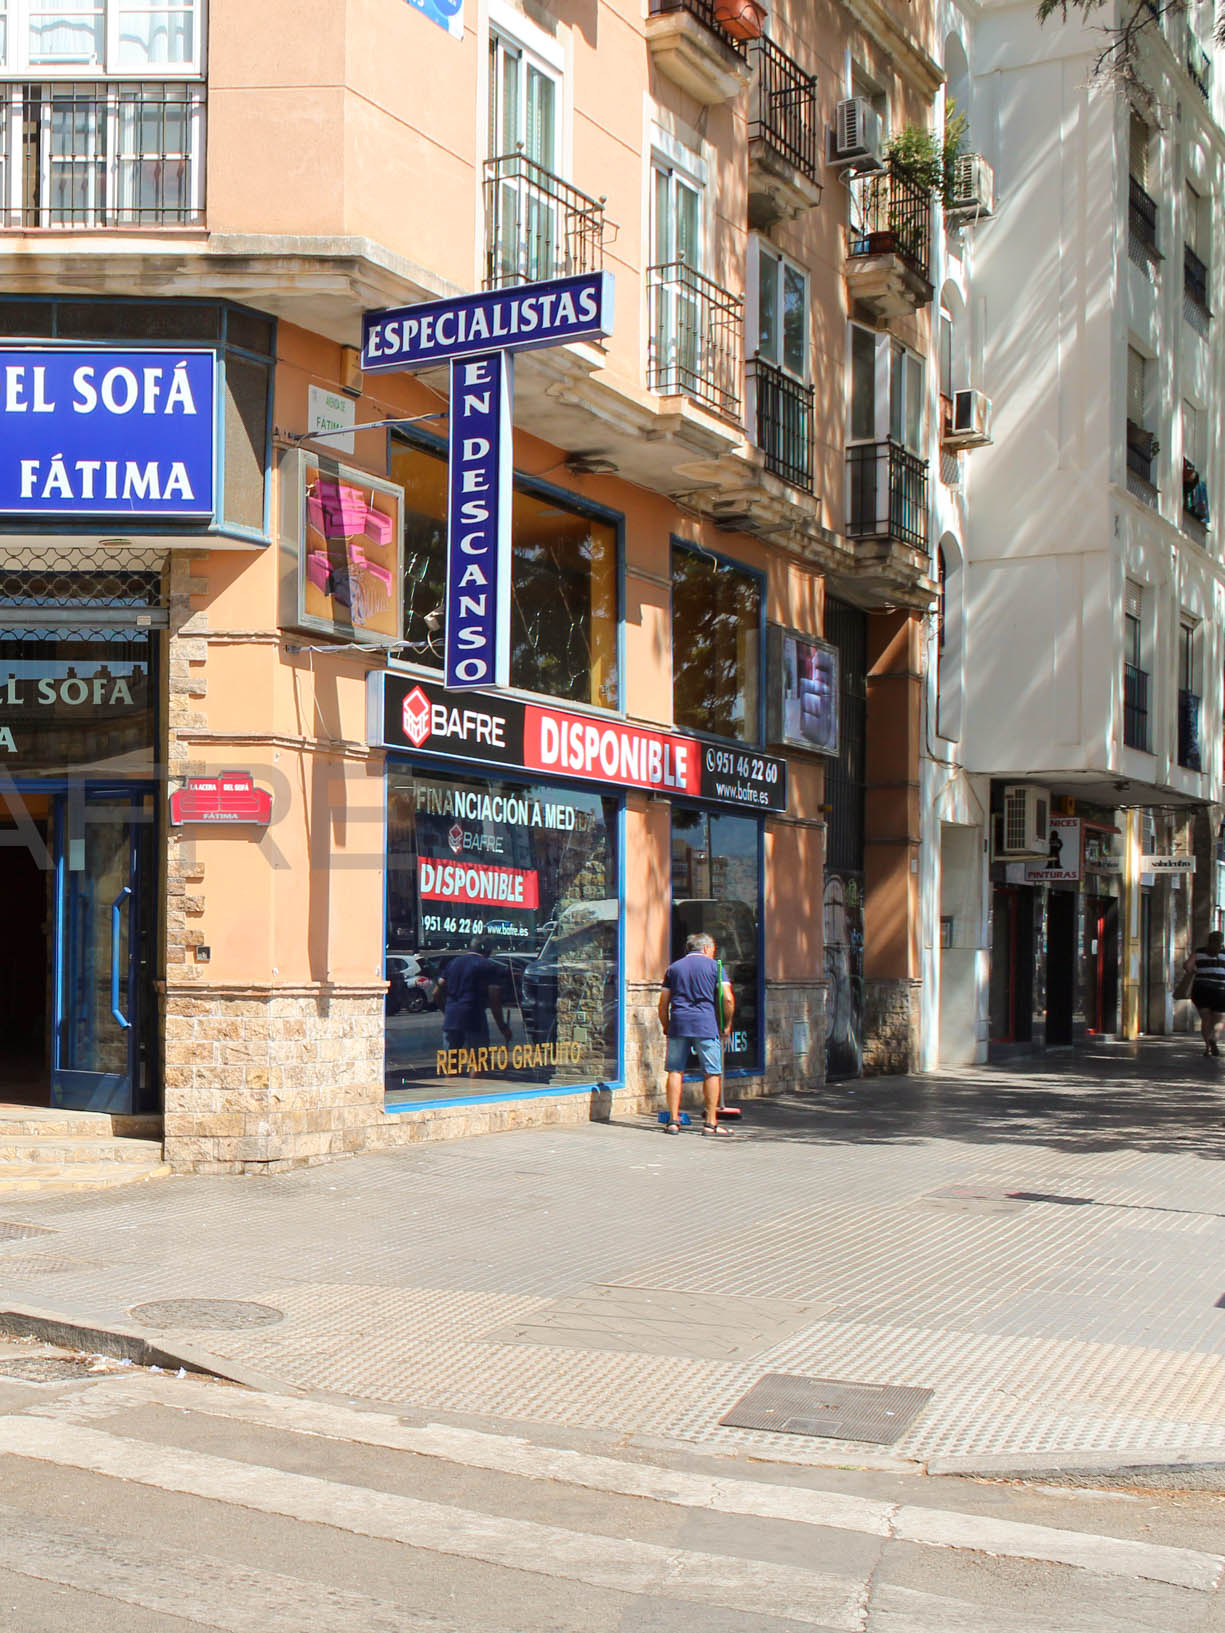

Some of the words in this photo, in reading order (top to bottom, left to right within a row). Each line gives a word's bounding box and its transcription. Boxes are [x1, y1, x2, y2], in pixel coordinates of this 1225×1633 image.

[368, 287, 598, 358] ESPECIALISTAS
[72, 361, 197, 415] SOFÁ
[463, 361, 491, 416] EN
[316, 415, 345, 430] FÁTIM
[19, 453, 195, 500] FÁTIMA
[455, 437, 491, 682] DESCANSO
[431, 704, 506, 748] BAFRE
[541, 715, 688, 789] DISPONIBLE
[716, 751, 734, 775] 951
[737, 757, 749, 778] 46
[752, 762, 763, 781] 22
[765, 763, 778, 784] 60
[416, 783, 528, 826] FINANCIACIÓN
[532, 802, 542, 827] A
[716, 781, 769, 806] www.bafre.es
[463, 832, 504, 854] BAFRE
[421, 864, 524, 902] DISPONIBLE
[425, 915, 441, 932] 951
[444, 917, 456, 933] 46
[459, 918, 471, 933] 22
[473, 919, 483, 935] 60
[487, 922, 529, 937] www.bafre.es
[437, 1045, 507, 1076] REPARTO
[512, 1041, 581, 1070] GRATUITO
